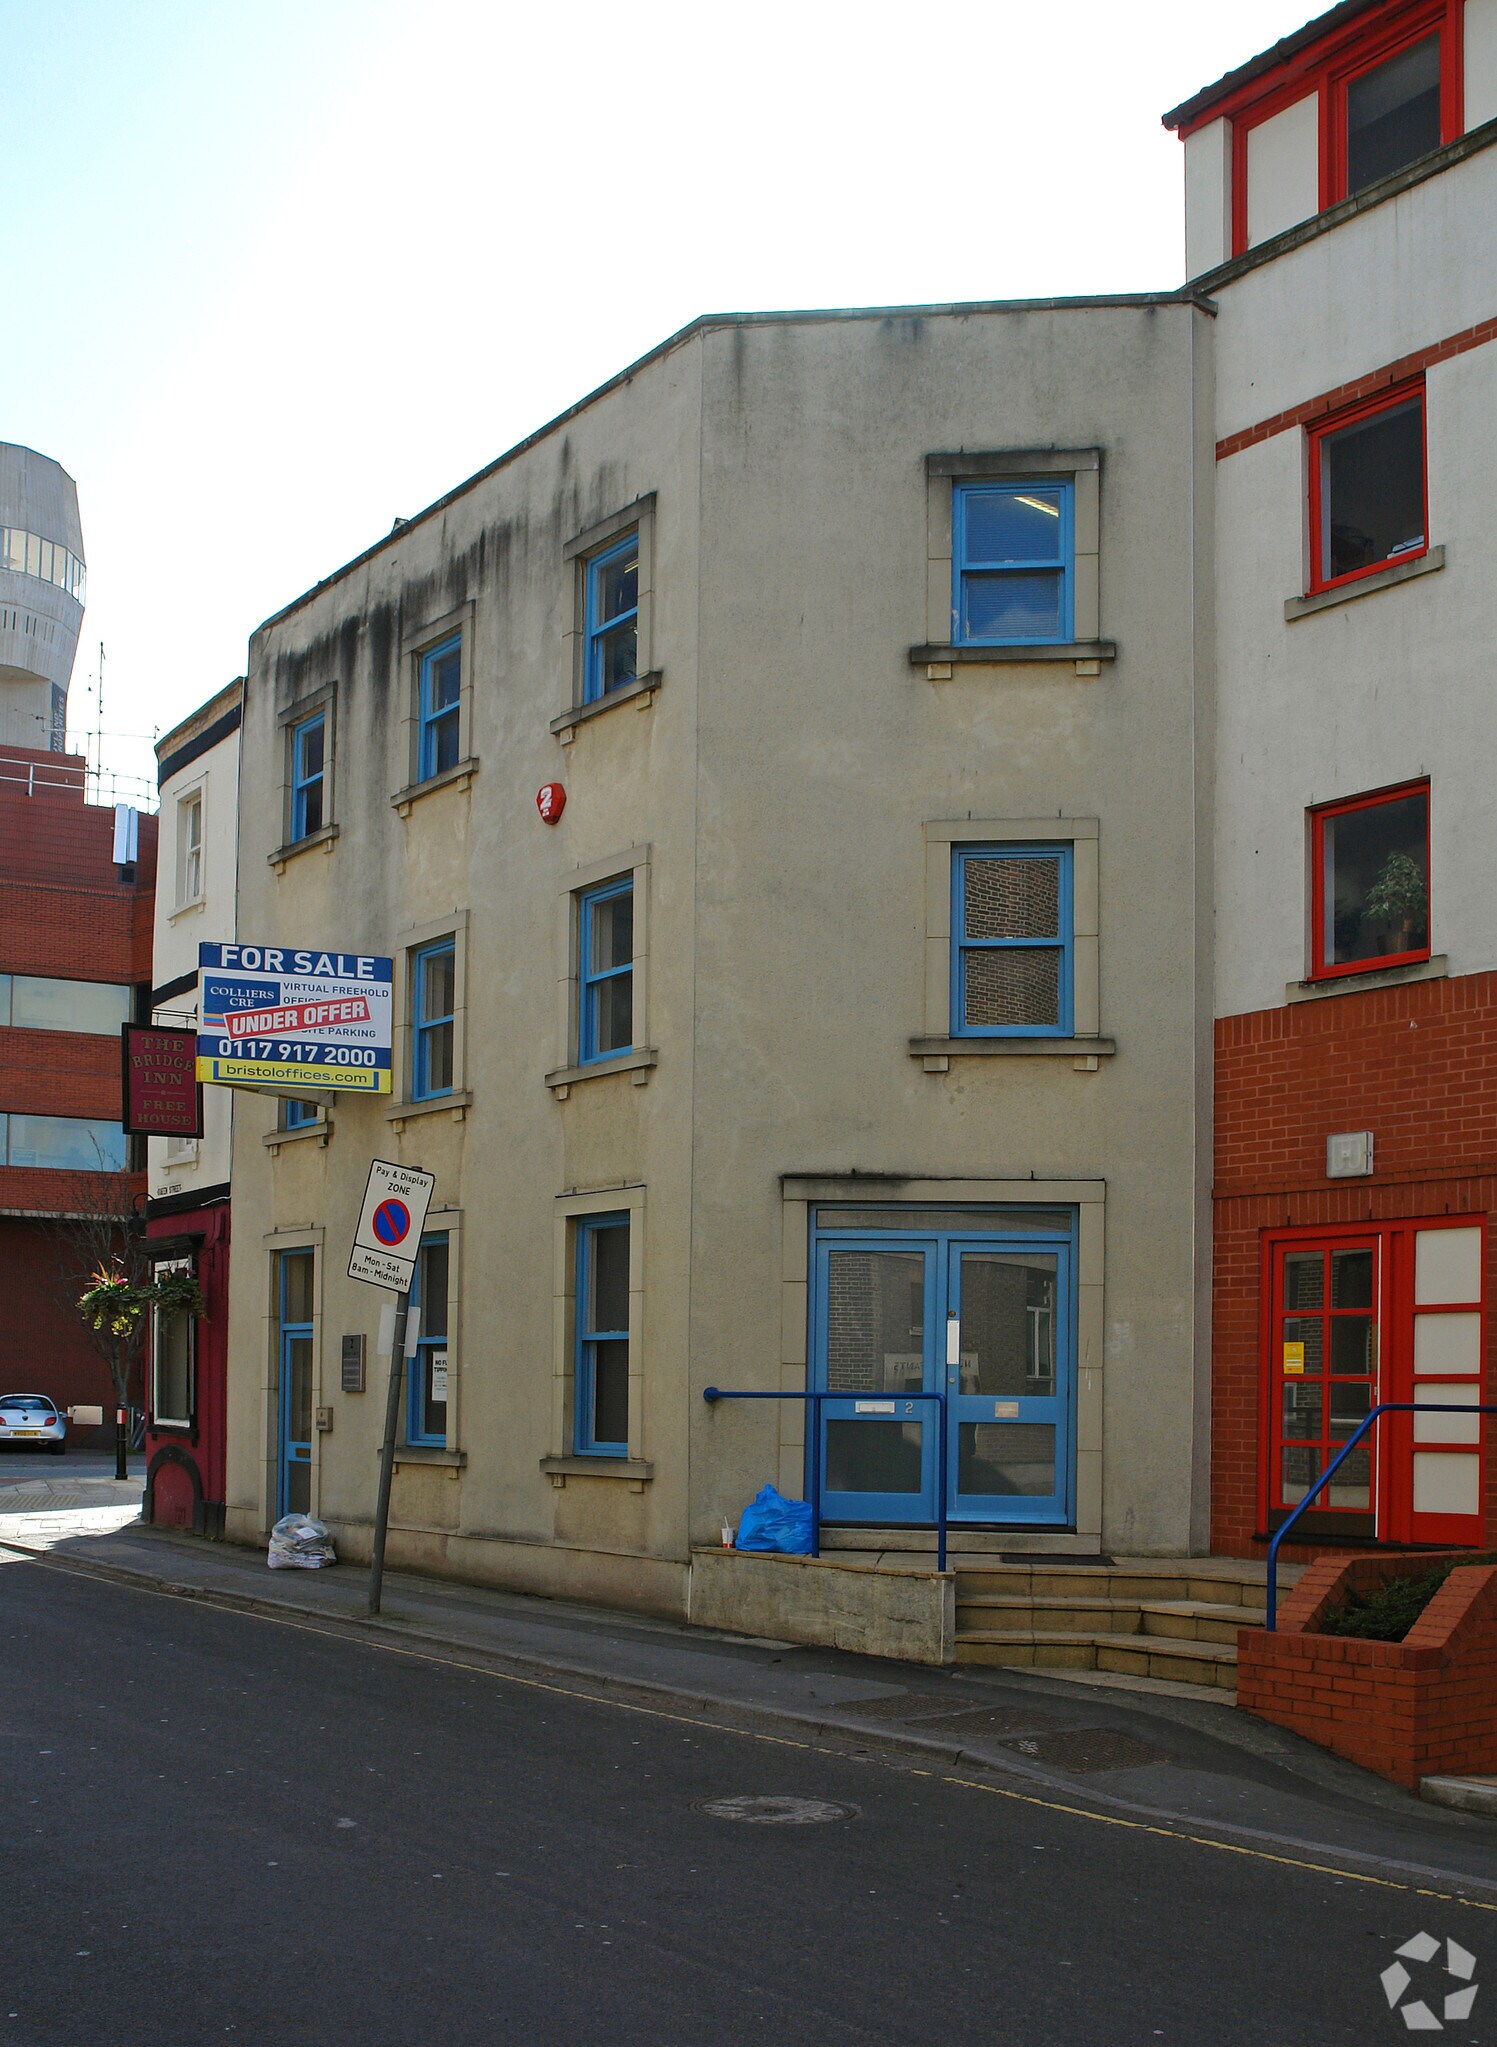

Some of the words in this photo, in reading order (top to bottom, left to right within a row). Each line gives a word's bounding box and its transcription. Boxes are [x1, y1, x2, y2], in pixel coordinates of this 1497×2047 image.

[220, 944, 284, 972] FOR
[293, 951, 375, 979] SALE
[210, 986, 275, 1000] COLLIERS
[283, 982, 329, 994] VIRTUAL
[332, 985, 389, 998] FREEHOLD
[229, 997, 255, 1007] CRE
[232, 1010, 298, 1035] UNDER
[303, 1000, 365, 1025] OFFER
[328, 1027, 376, 1039] PARKING
[141, 1036, 184, 1052] THE
[218, 1039, 272, 1059] 0117
[278, 1043, 318, 1062] 917
[324, 1047, 376, 1066] 2000
[131, 1054, 195, 1073] BRIDGE
[143, 1071, 183, 1085] INN
[226, 1064, 368, 1083] bristoloffices.com
[143, 1100, 186, 1112] FREE
[136, 1112, 192, 1126] HOUSE
[375, 1165, 389, 1178] Pay
[392, 1170, 398, 1178] &
[400, 1172, 429, 1188] Display
[387, 1182, 411, 1196] ZONE
[364, 1255, 381, 1267] Mon
[386, 1262, 400, 1273] Sat
[351, 1262, 369, 1274] 8am
[374, 1268, 408, 1287] Midnight
[904, 1402, 914, 1414] 2
